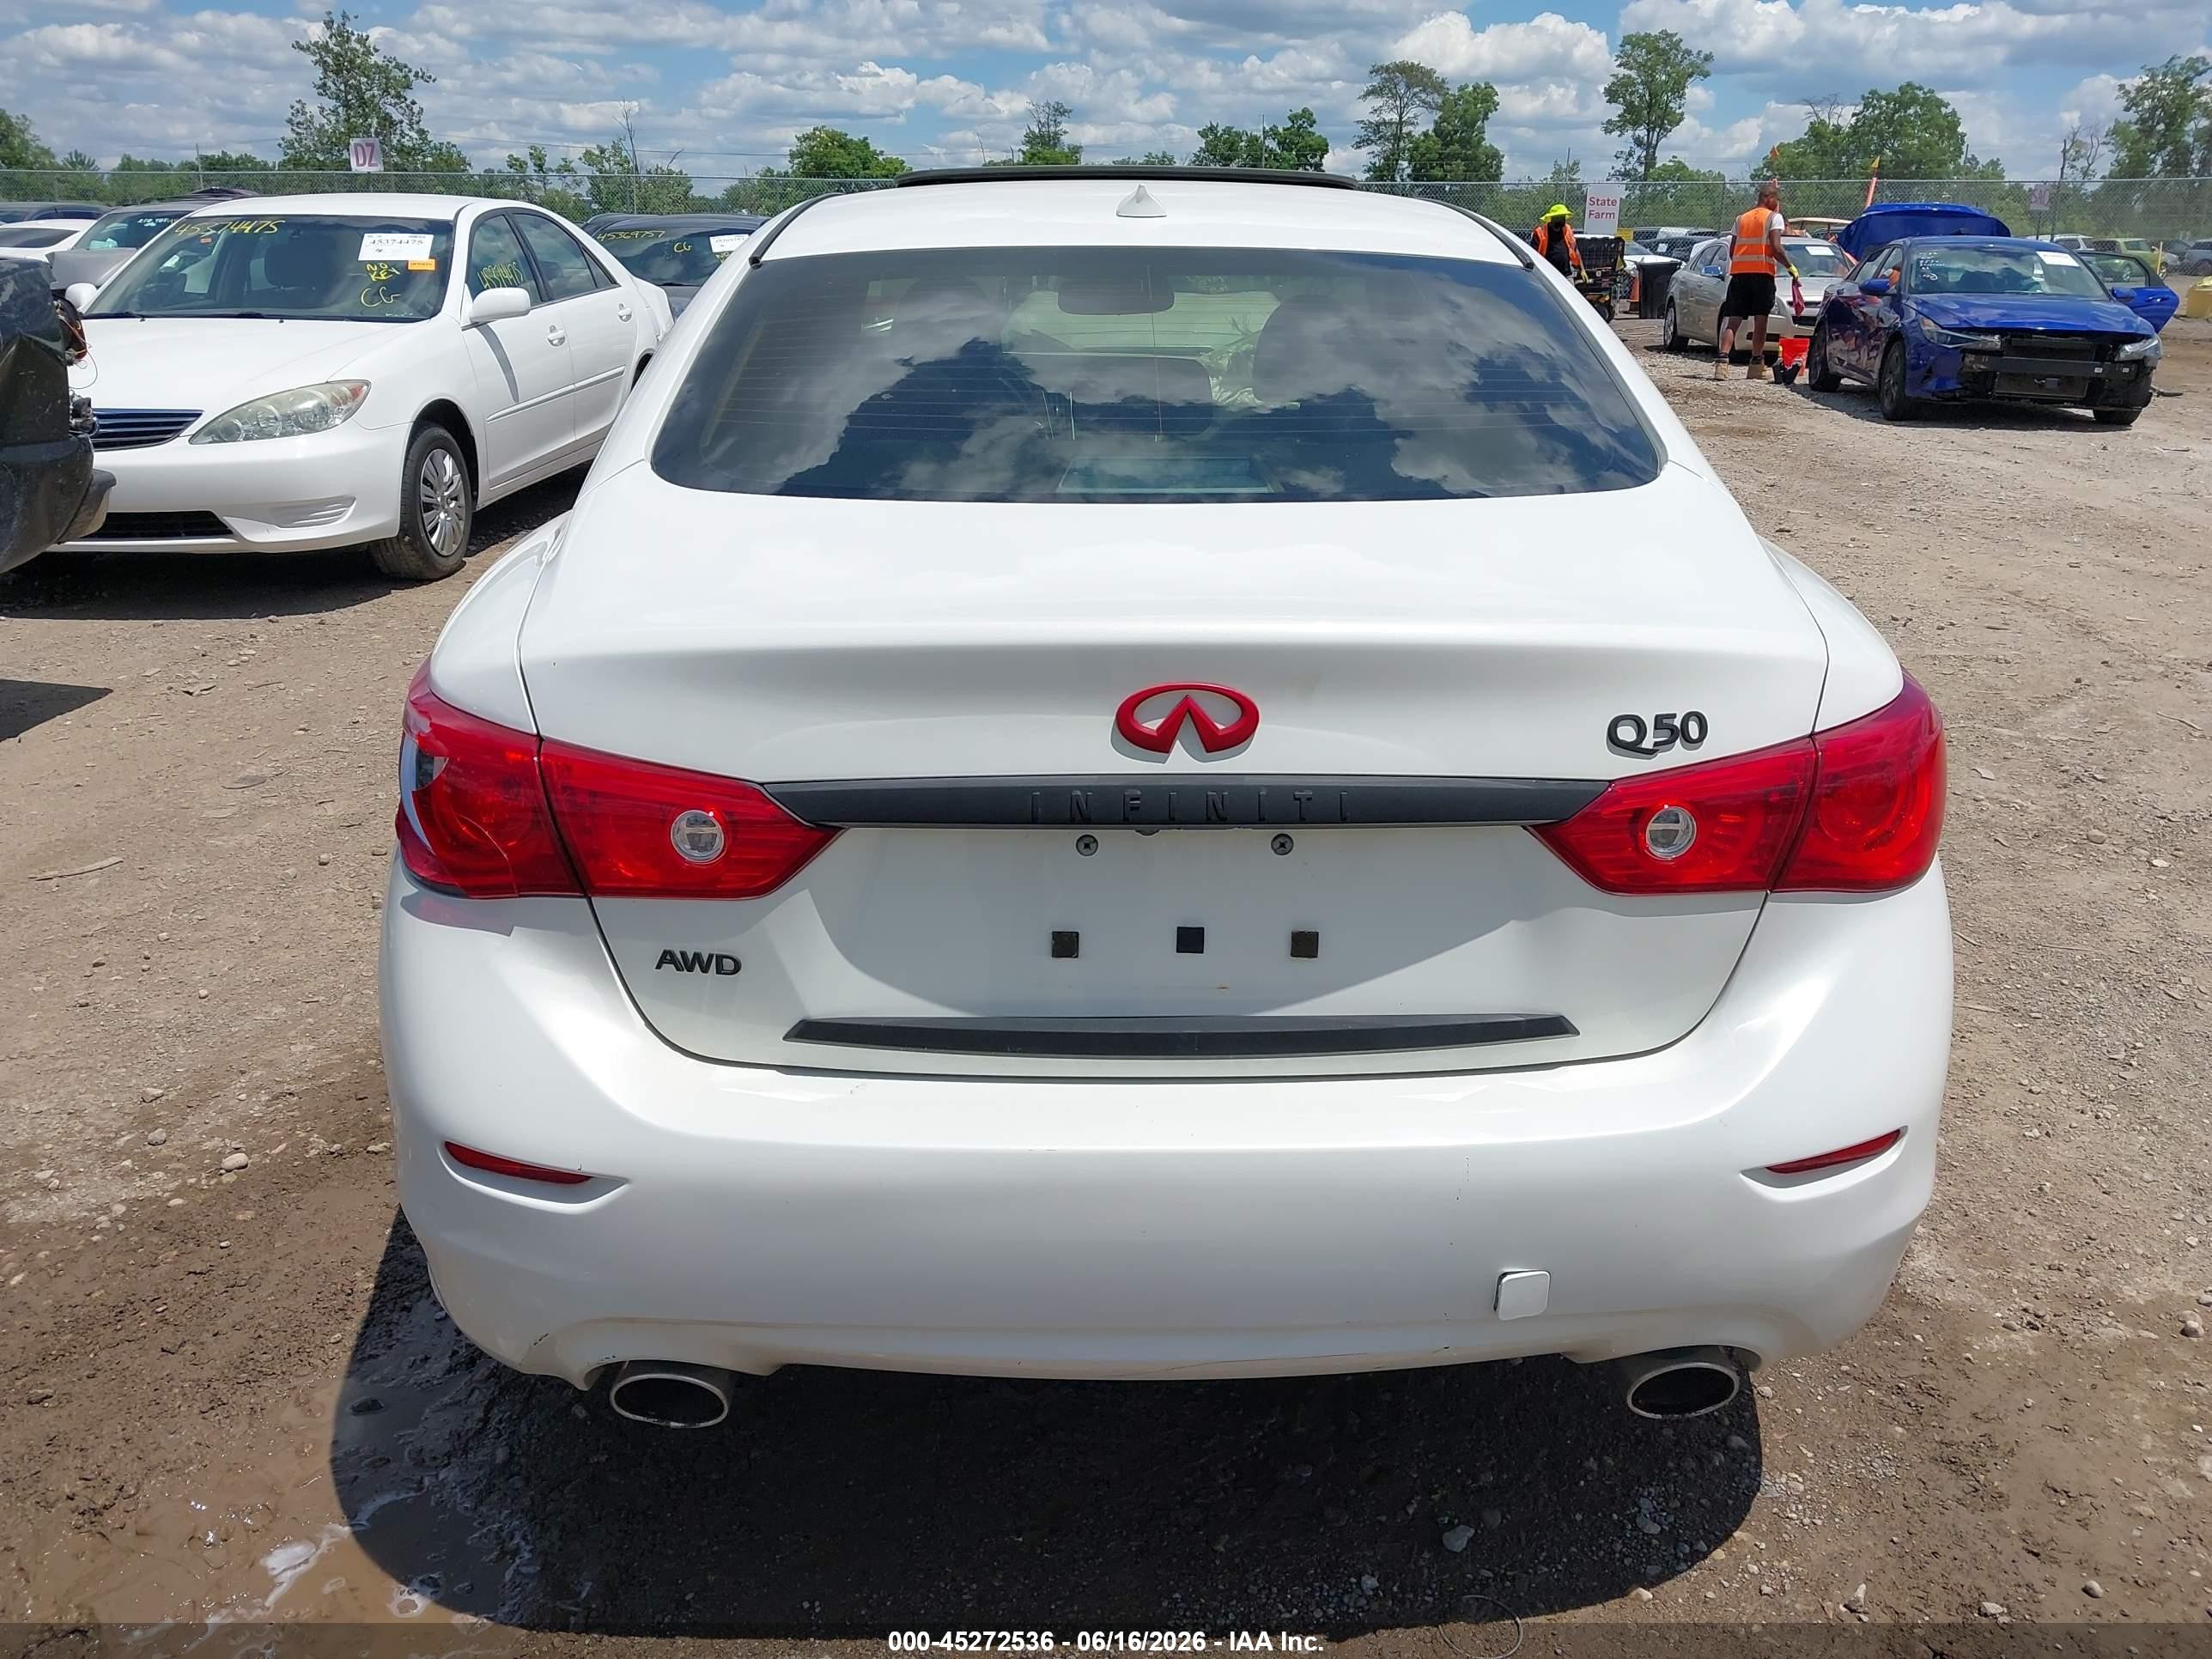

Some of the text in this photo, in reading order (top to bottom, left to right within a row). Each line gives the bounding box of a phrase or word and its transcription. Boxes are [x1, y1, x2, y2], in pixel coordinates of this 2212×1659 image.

[1589, 197, 1617, 206] State
[1589, 210, 1615, 220] Farm
[673, 241, 694, 252] CG
[369, 267, 401, 282] KEY
[361, 286, 403, 307] CG
[1606, 711, 1709, 759] Q50
[1030, 790, 1348, 822] INFINITI
[653, 948, 743, 976] AWD
